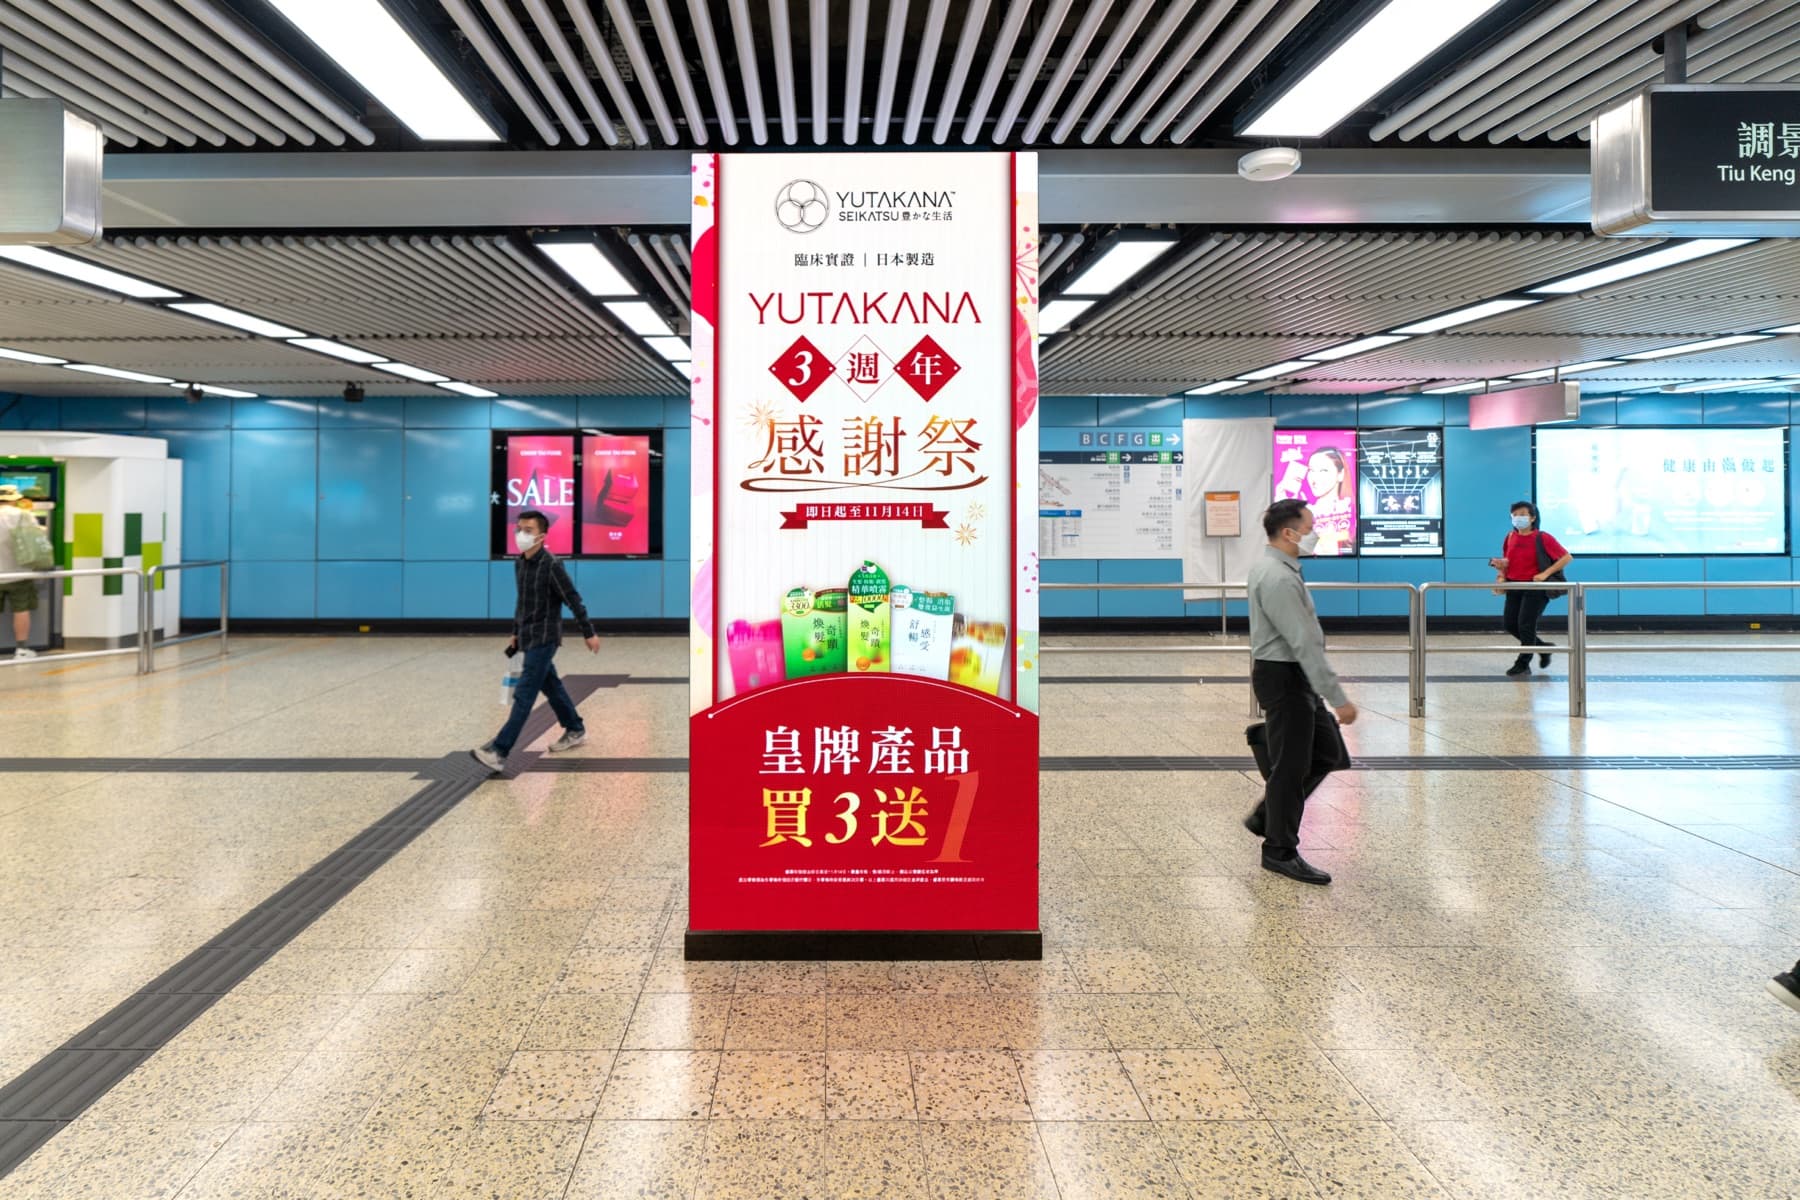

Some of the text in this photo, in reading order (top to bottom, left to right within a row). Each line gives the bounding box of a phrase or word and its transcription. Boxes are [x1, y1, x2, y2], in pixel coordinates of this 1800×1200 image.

[1716, 164, 1796, 186] Tiu Keng
[838, 210, 900, 222] SEIKATSU
[794, 252, 935, 267] 臨床實證 日本製造
[748, 291, 982, 325] YUTAKANA
[748, 413, 984, 478] 感謝祭
[1082, 434, 1143, 445] B C F G
[506, 478, 576, 507] SALE
[805, 504, 923, 518] 即日起至11月14日
[758, 725, 970, 775] 皇牌產品
